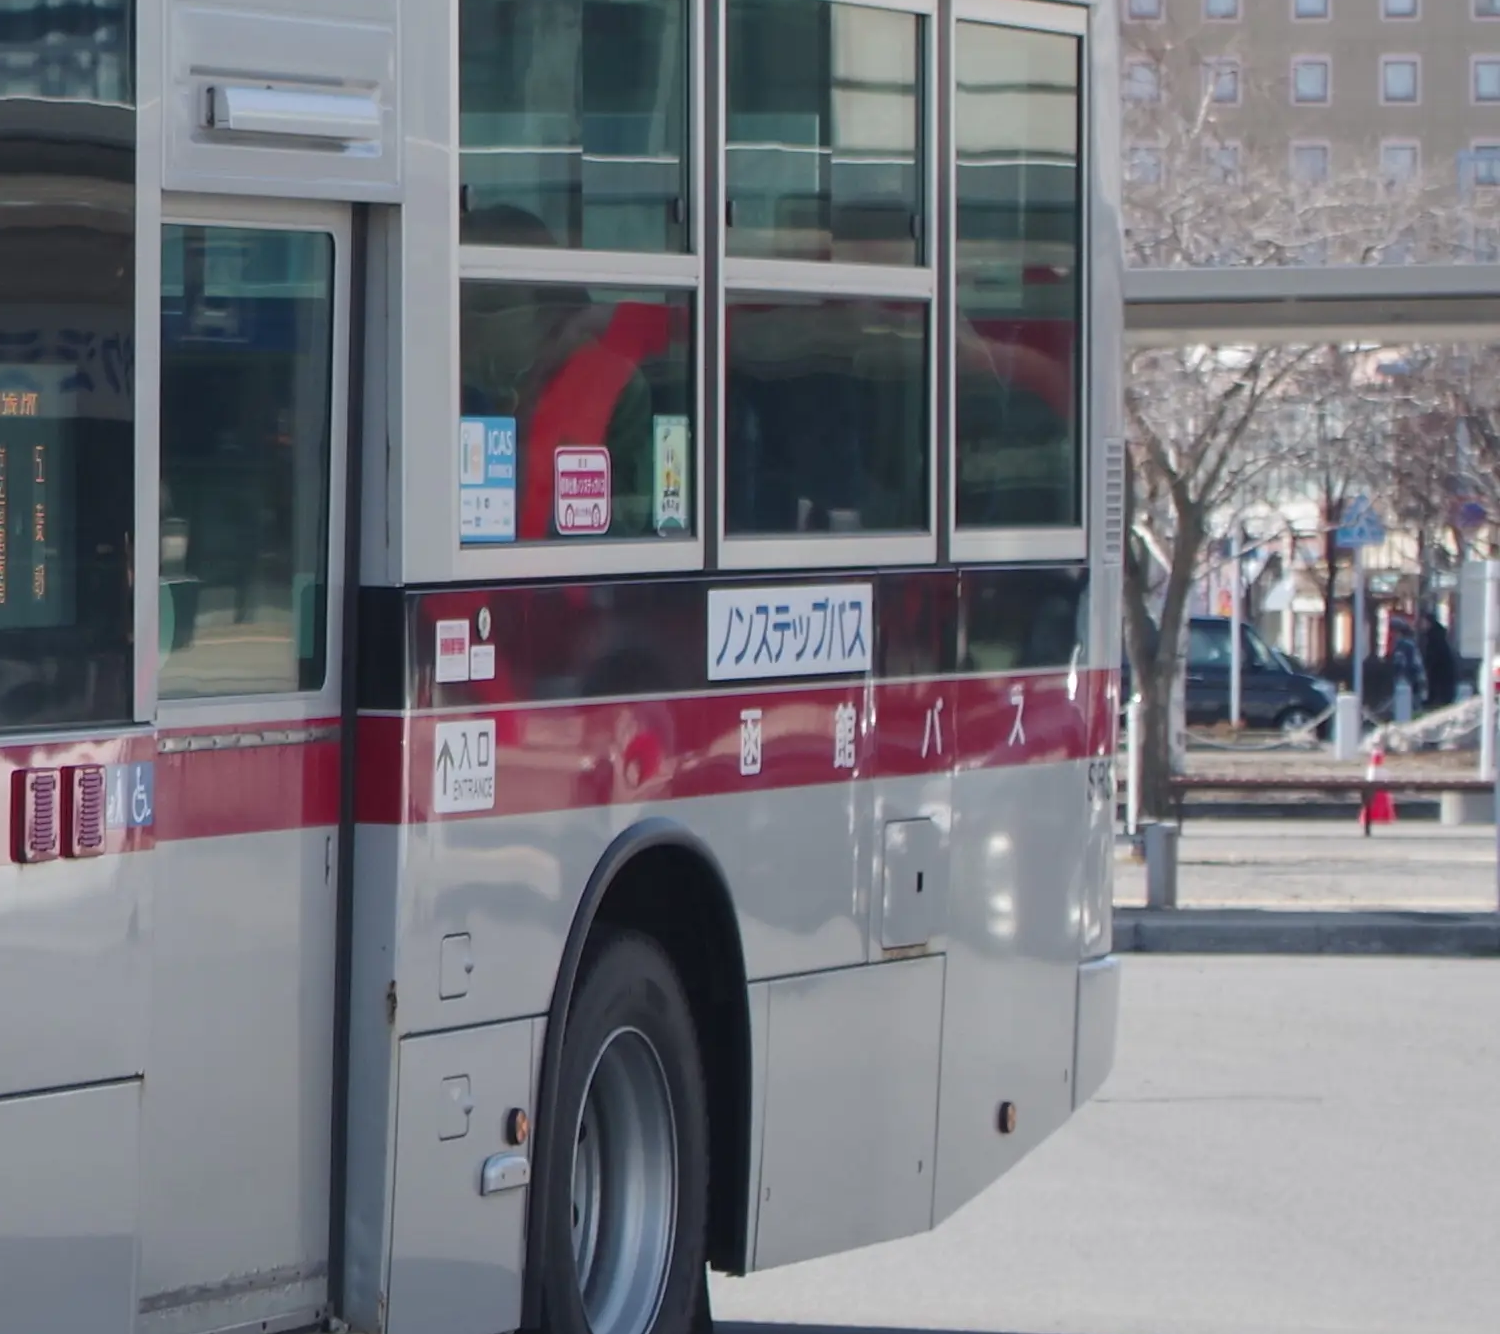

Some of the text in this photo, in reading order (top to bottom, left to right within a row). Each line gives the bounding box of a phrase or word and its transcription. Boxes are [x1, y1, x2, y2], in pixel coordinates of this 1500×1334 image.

[715, 596, 867, 667] ノンステップバス
[458, 731, 490, 770] 入口
